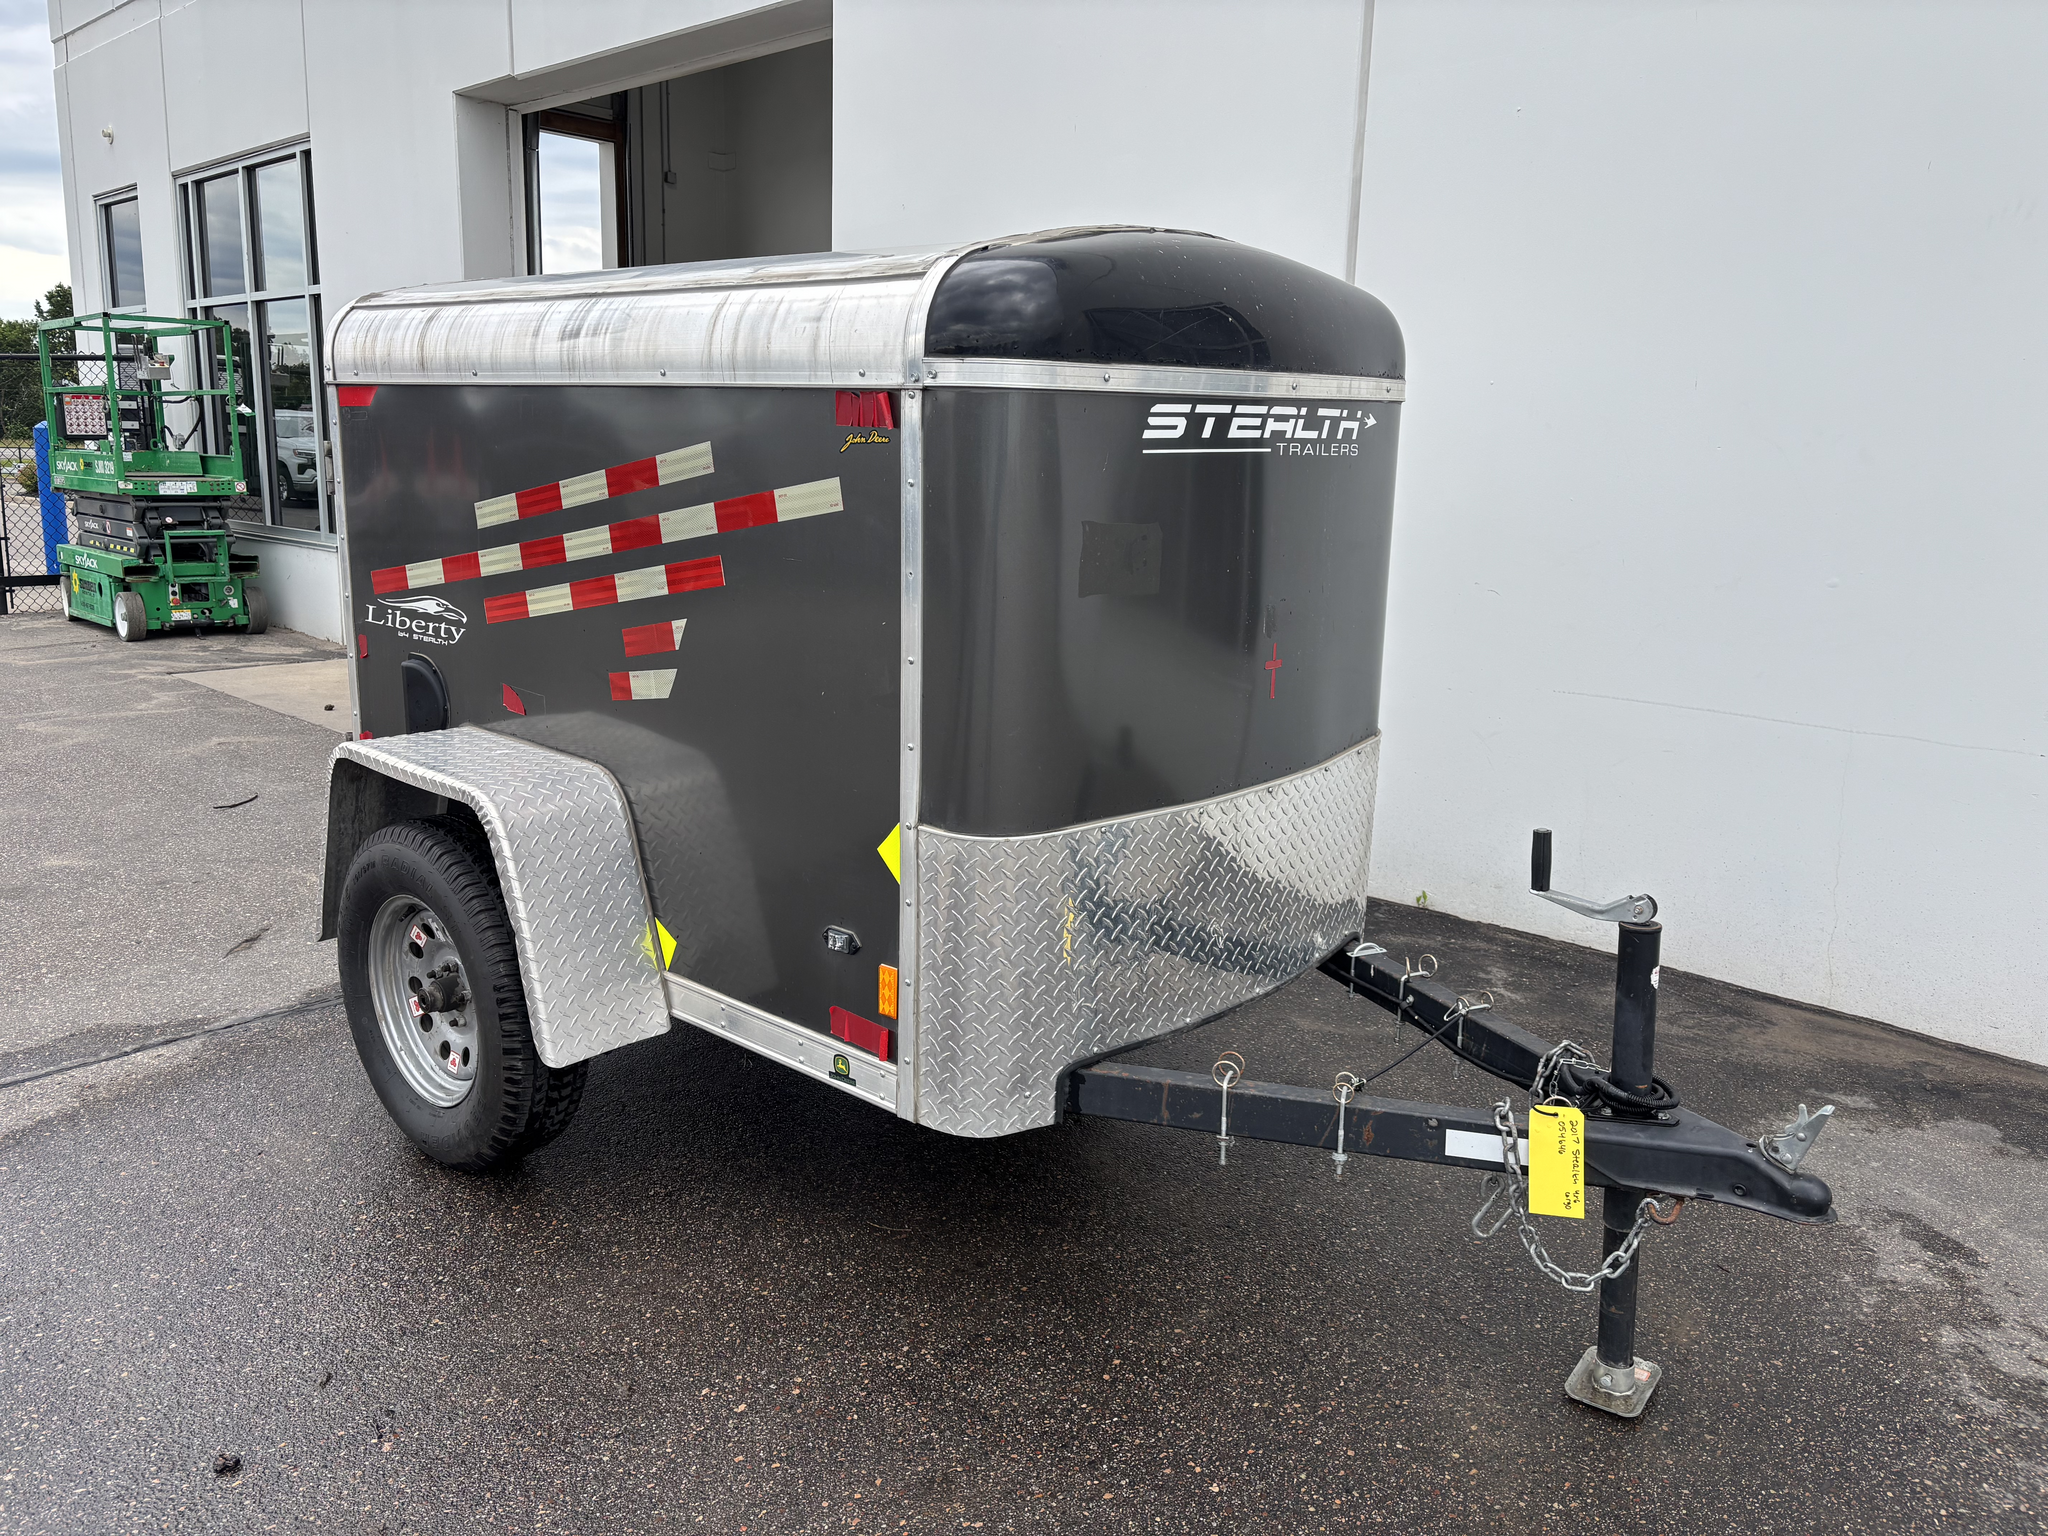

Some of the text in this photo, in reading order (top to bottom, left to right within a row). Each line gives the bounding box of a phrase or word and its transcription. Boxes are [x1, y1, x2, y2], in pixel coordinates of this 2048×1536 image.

[1142, 404, 1363, 440] STEALTH
[840, 430, 891, 453] John Deere
[1276, 443, 1359, 457] TRAILERS
[56, 456, 78, 473] SKYJACK
[84, 519, 99, 529] SKYJACK
[75, 553, 98, 569] SKYJACK
[365, 604, 466, 644] Liberty
[412, 634, 448, 646] STEALTH
[380, 854, 434, 899] RADIAL
[1569, 1120, 1580, 1145] 2017
[1572, 1149, 1580, 1185] Stealth
